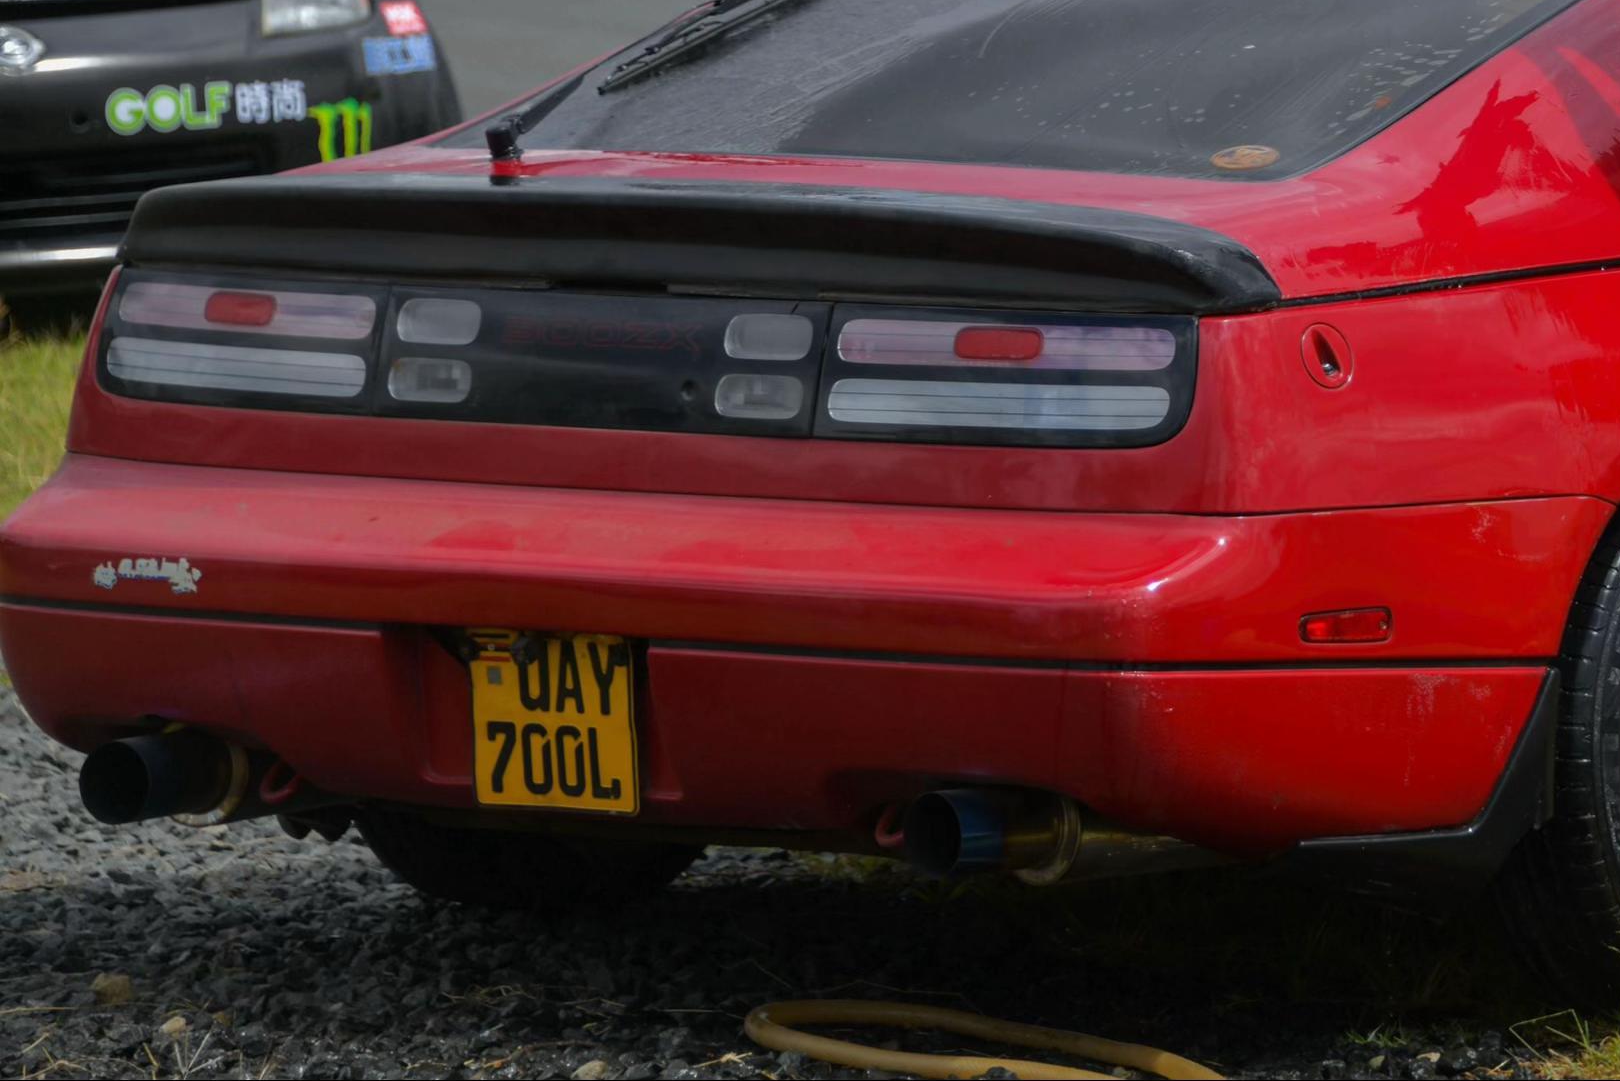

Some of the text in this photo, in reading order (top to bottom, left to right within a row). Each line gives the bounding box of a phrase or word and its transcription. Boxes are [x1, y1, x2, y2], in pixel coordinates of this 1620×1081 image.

[105, 79, 307, 136] GOLF 時尚
[487, 721, 622, 800] 700L
